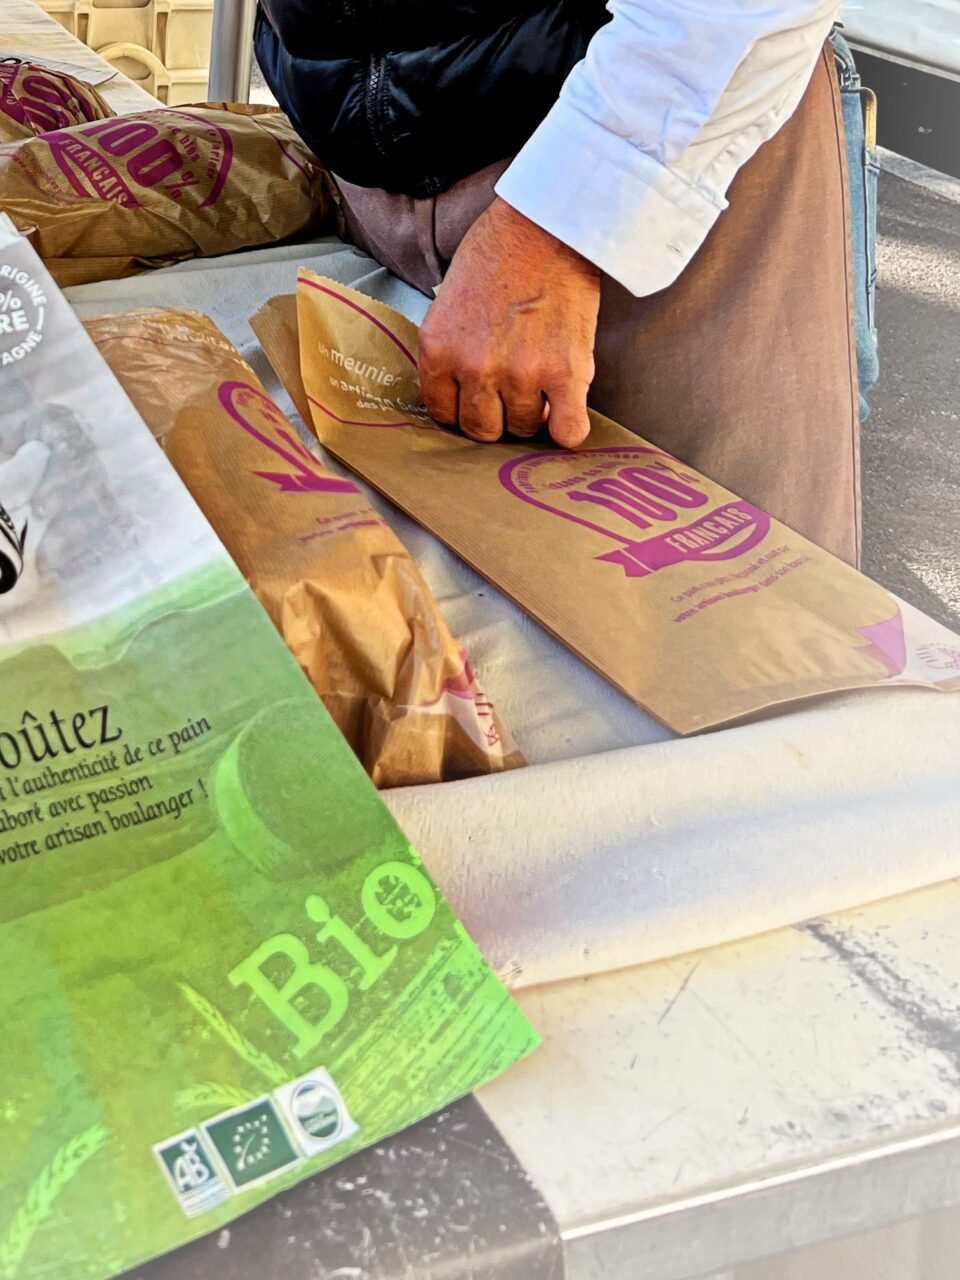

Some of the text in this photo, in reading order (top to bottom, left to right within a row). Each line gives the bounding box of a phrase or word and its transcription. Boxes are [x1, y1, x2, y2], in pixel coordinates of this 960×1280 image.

[57, 138, 129, 204] FRANÇAIS
[566, 460, 701, 531] 100%
[8, 750, 121, 798] l'authenticité
[123, 744, 145, 767] de
[148, 736, 166, 756] ce
[168, 716, 212, 754] pain
[45, 821, 107, 852] artisan
[105, 786, 196, 833] boulanger
[48, 794, 86, 819] avec
[87, 774, 154, 814] passion
[228, 860, 436, 1060] Bio
[173, 1150, 210, 1193] AB
